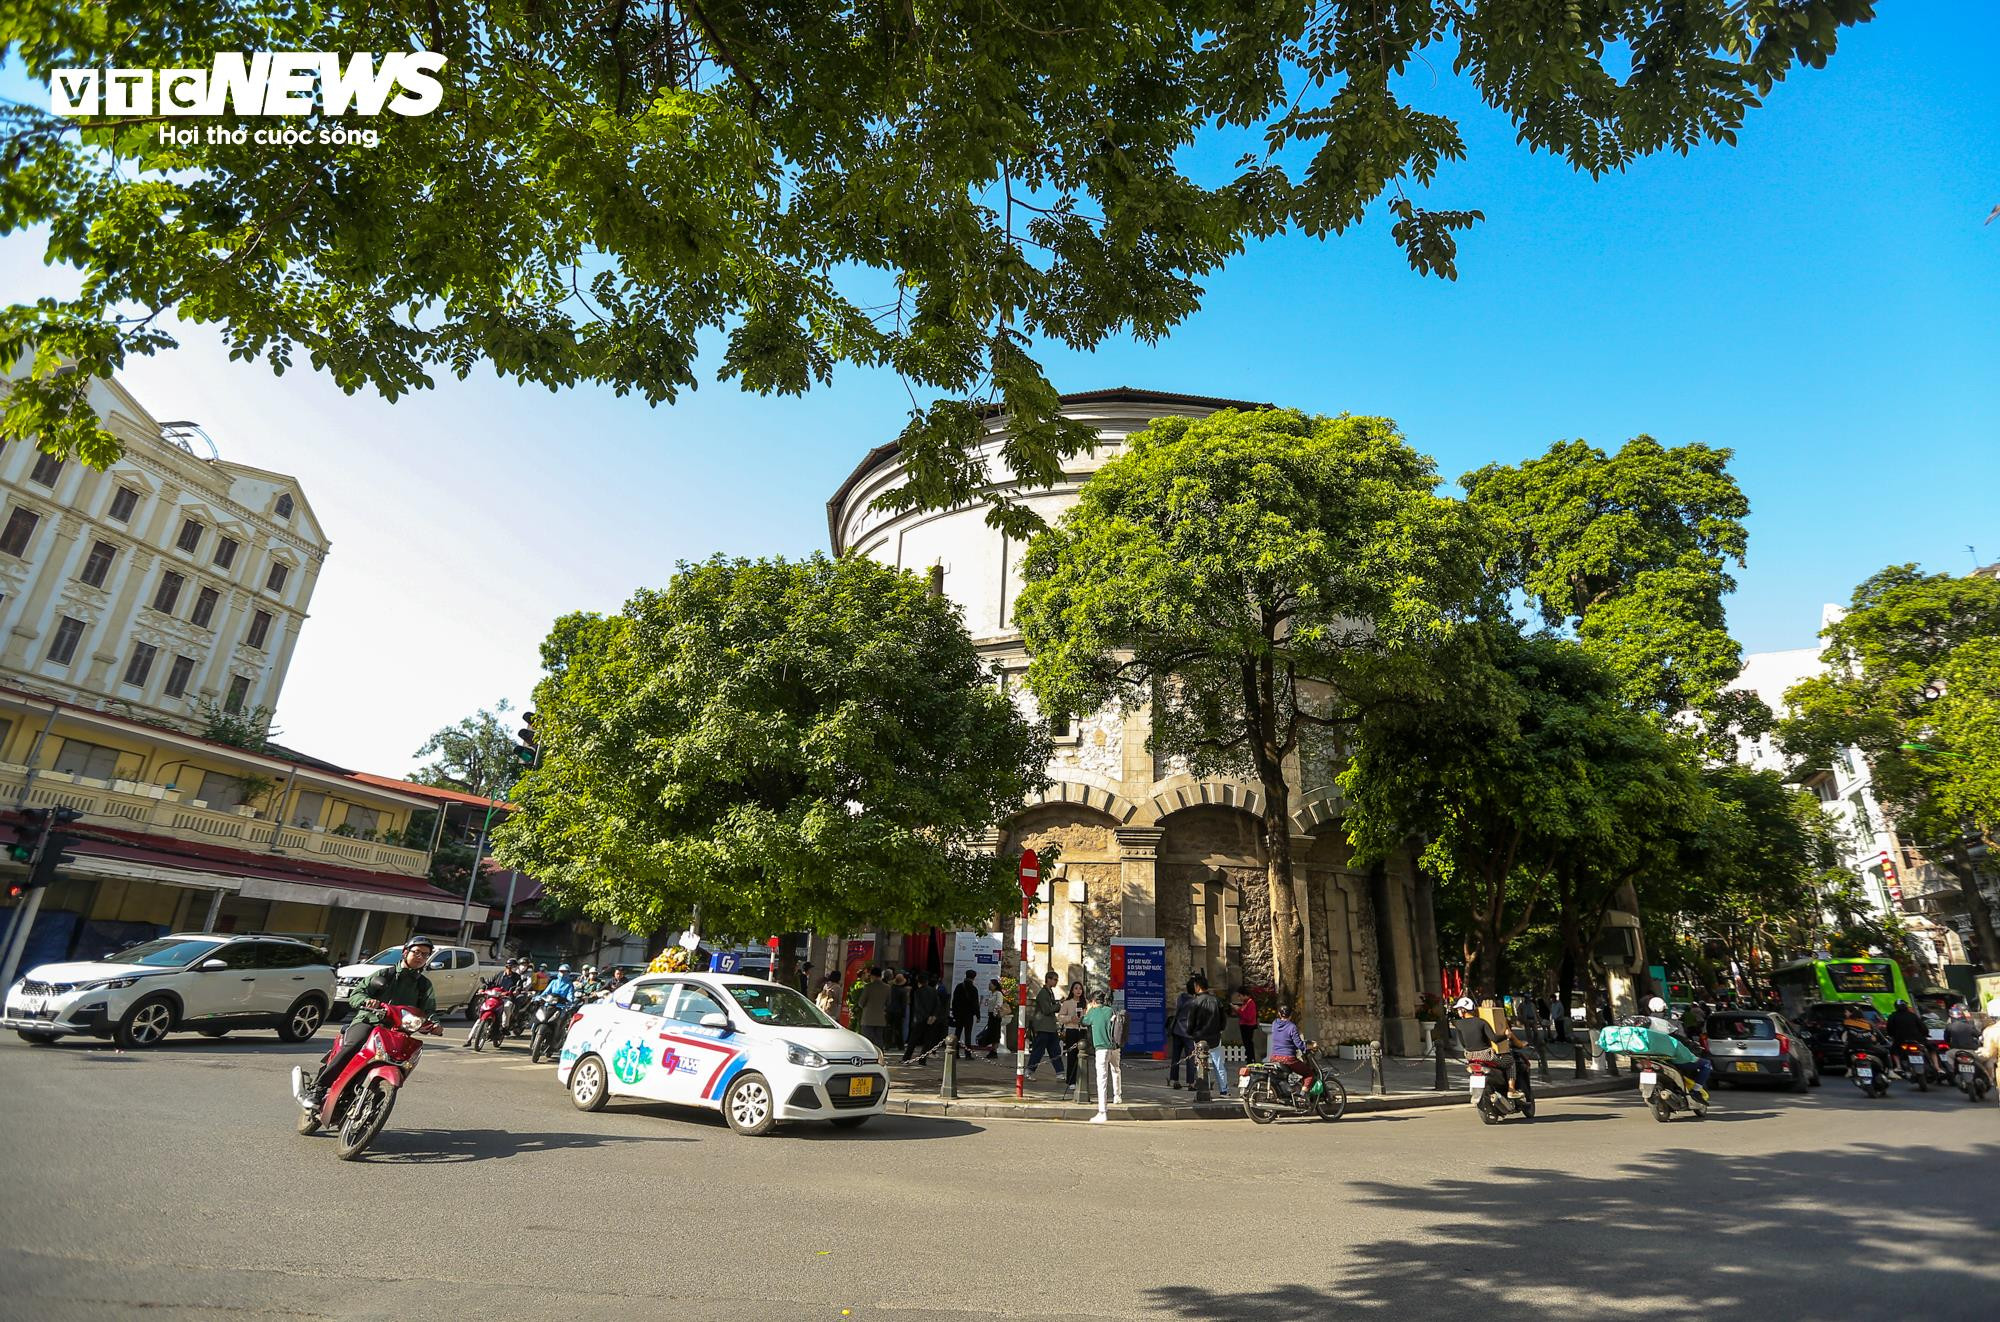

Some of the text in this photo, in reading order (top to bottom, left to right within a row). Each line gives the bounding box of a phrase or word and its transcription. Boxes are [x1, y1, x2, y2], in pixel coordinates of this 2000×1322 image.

[721, 955, 735, 972] G7
[662, 1047, 699, 1075] G7 TAXI
